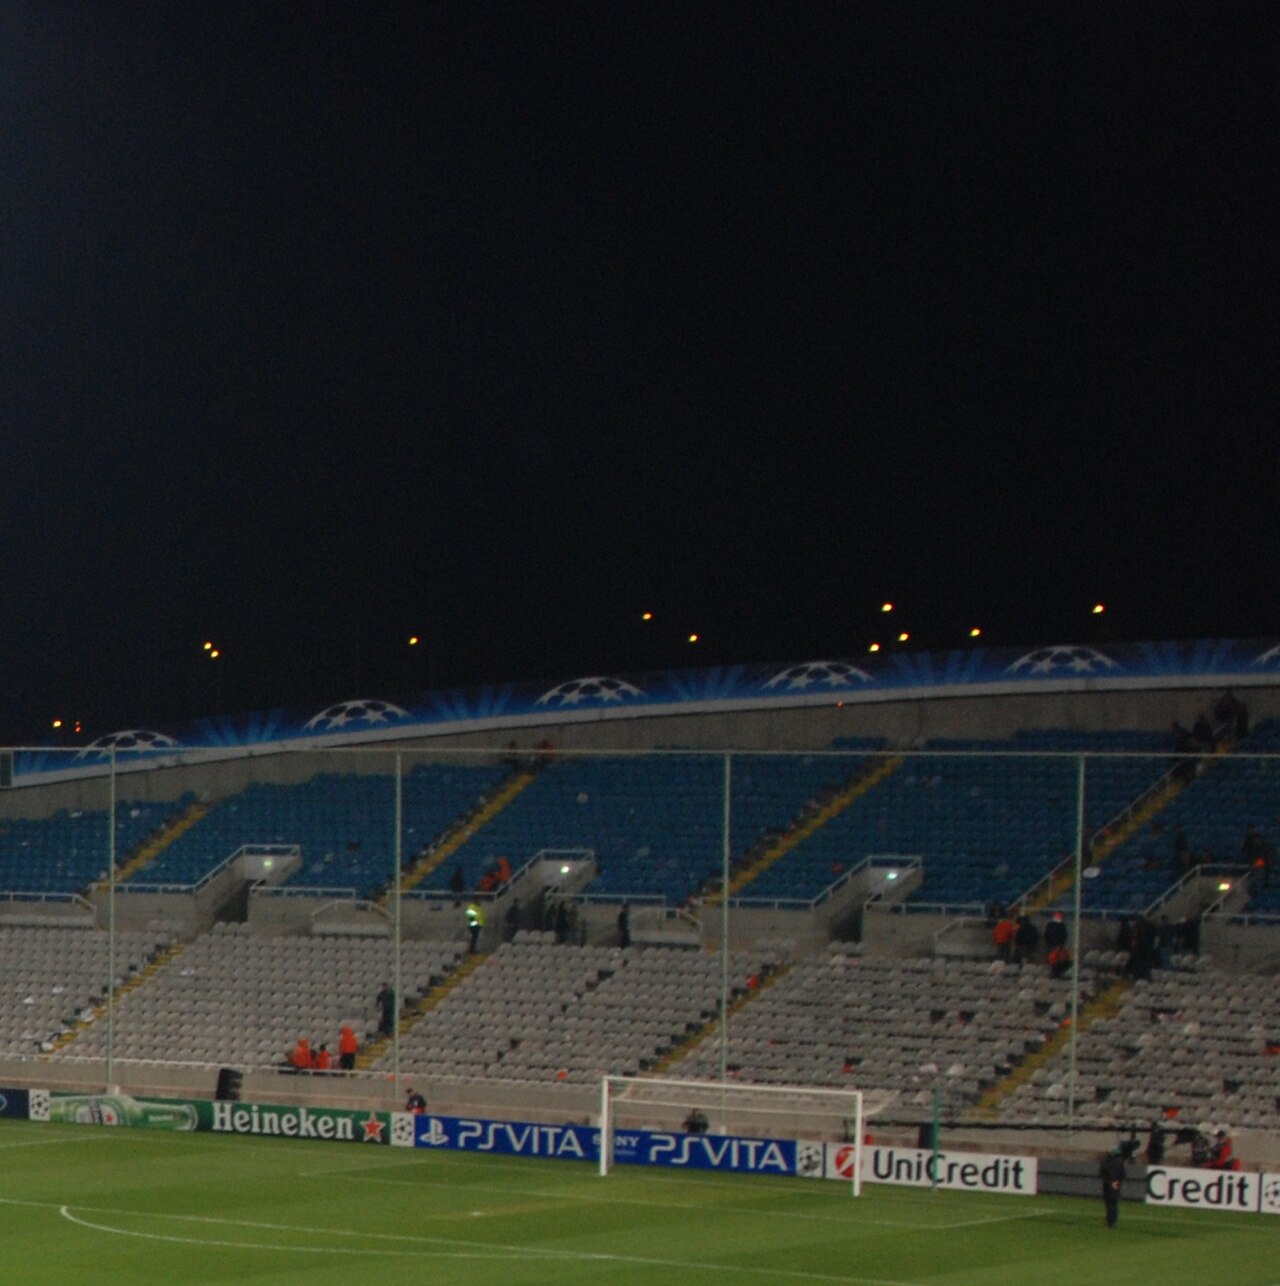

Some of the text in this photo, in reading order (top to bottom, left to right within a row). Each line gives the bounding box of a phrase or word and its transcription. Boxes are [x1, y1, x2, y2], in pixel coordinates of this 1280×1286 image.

[211, 1102, 354, 1139] Heineken
[593, 1133, 639, 1147] SNY
[873, 1149, 1024, 1190] UniCredit
